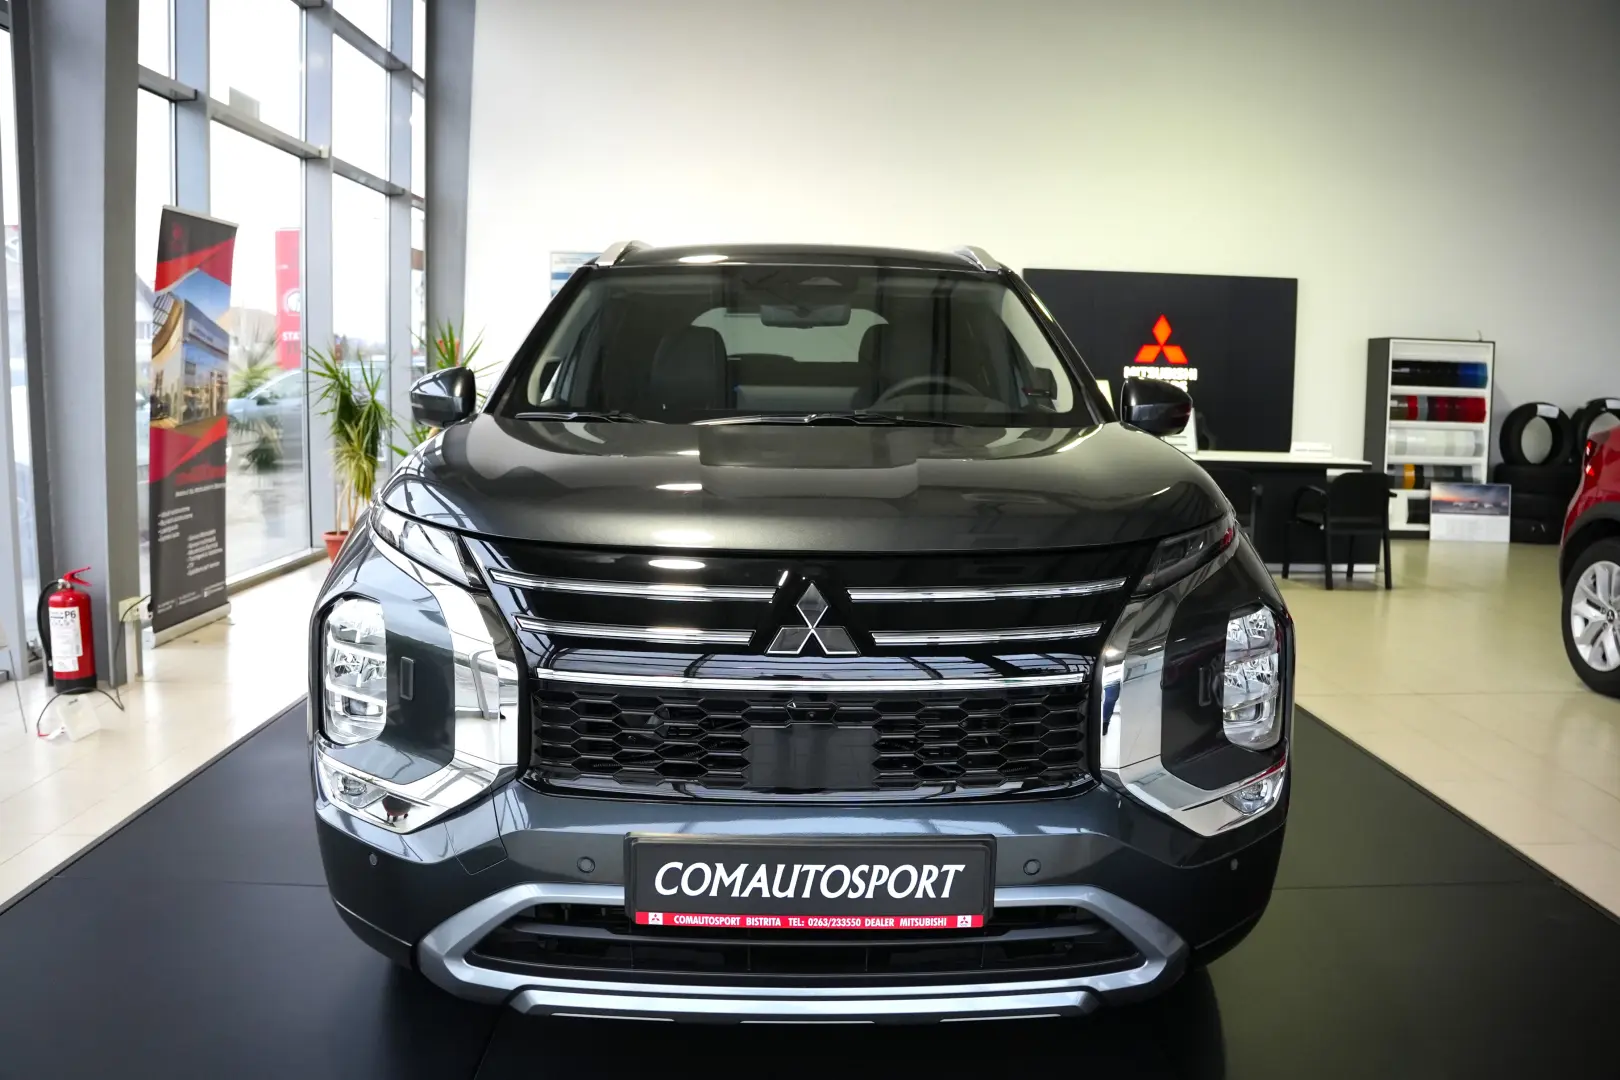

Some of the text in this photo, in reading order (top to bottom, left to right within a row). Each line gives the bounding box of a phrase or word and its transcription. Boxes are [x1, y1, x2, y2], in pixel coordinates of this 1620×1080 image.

[64, 610, 77, 619] P6
[654, 861, 966, 899] COMAUTOSPORT
[673, 915, 947, 928] COMAUTOSPORT BISTRITA TEL: 0263/233550 DEALER MITSUBISHI
